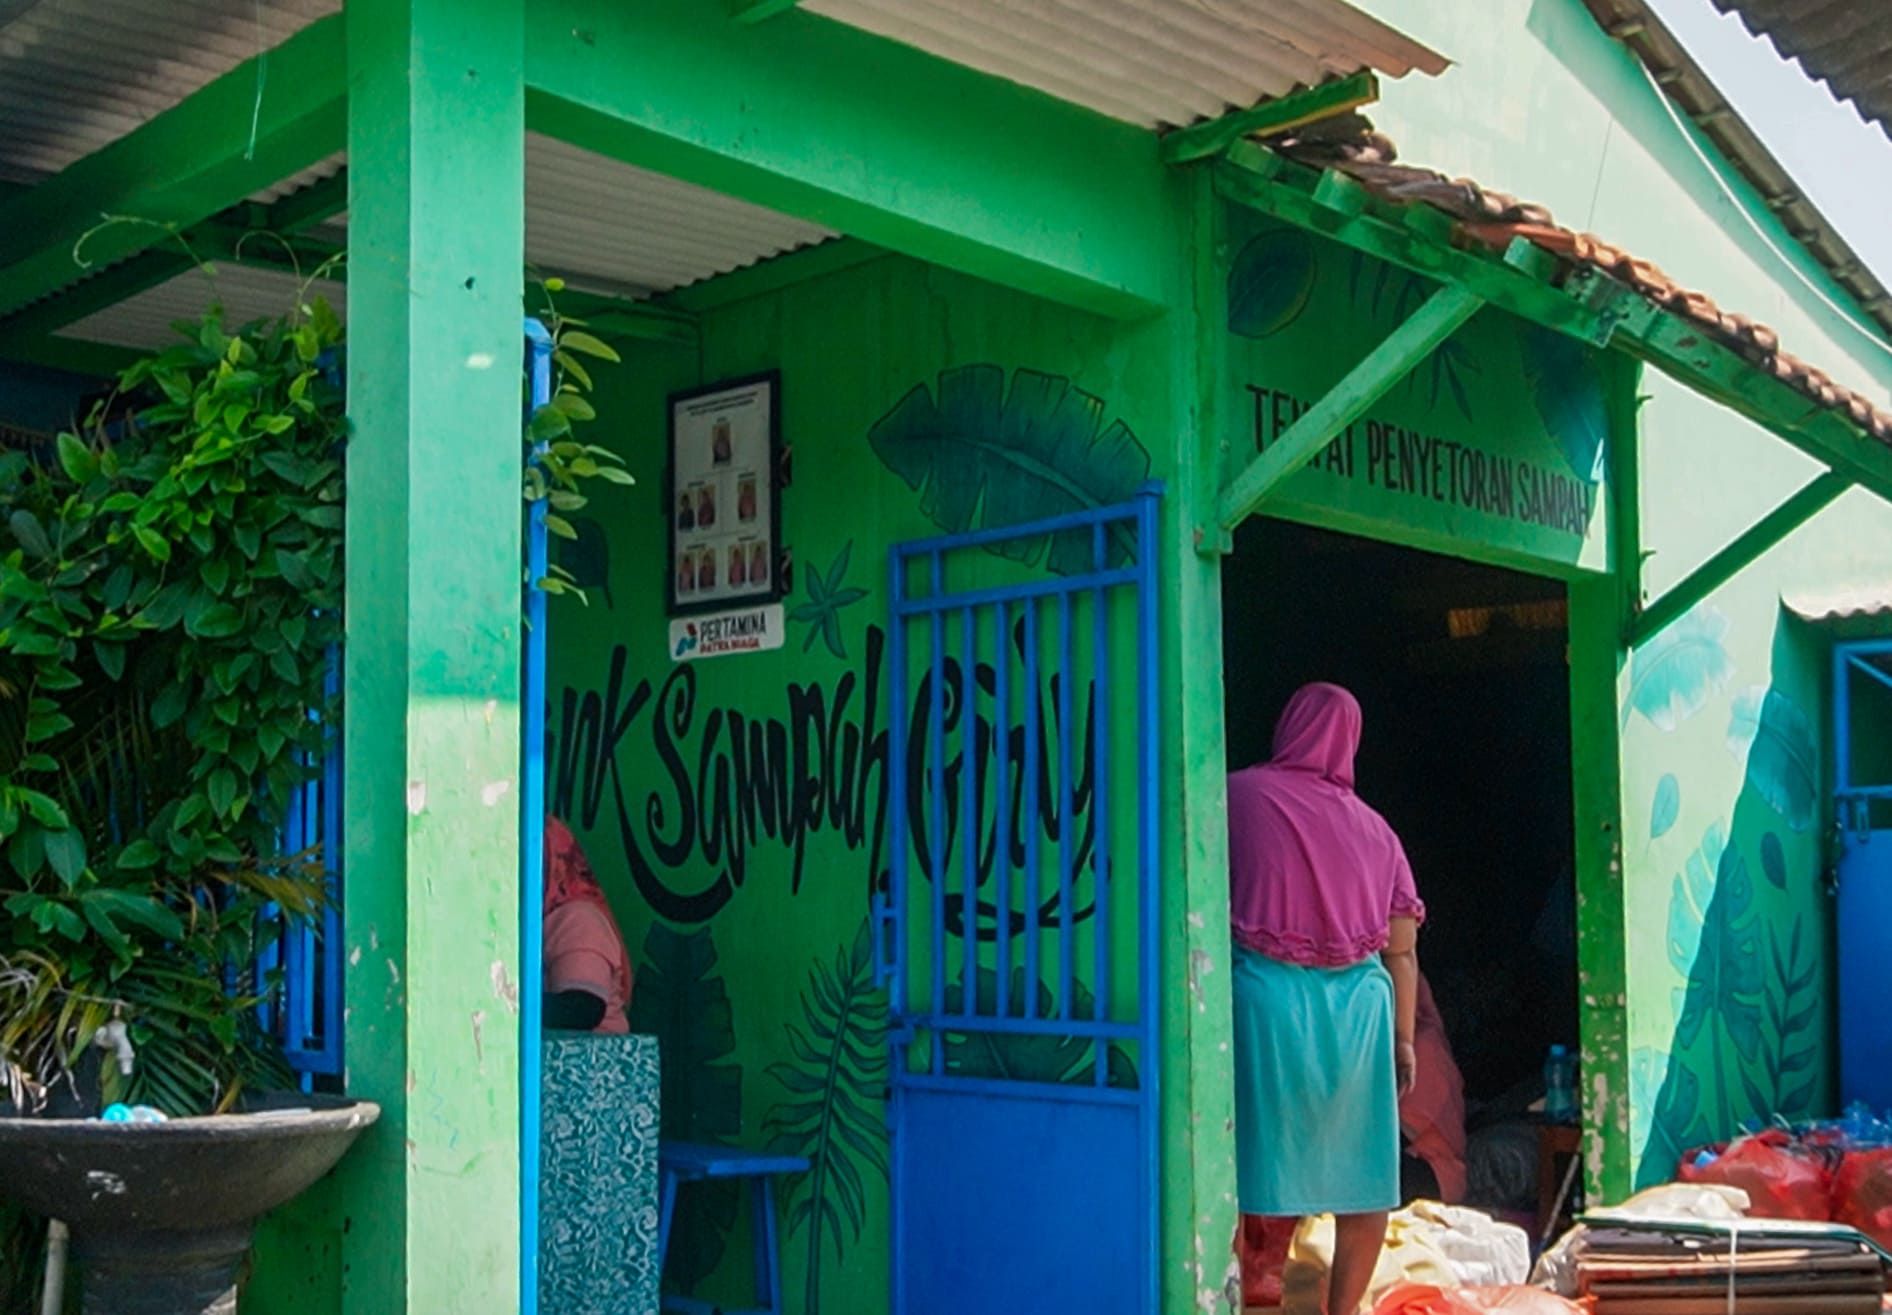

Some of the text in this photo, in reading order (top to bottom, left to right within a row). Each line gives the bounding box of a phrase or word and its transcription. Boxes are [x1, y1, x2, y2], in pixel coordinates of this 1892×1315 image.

[1367, 419, 1514, 518] PENYETORAN
[1518, 462, 1592, 540] SAMPAH
[700, 611, 767, 641] PERTAMINA
[647, 624, 895, 926] Sampah
